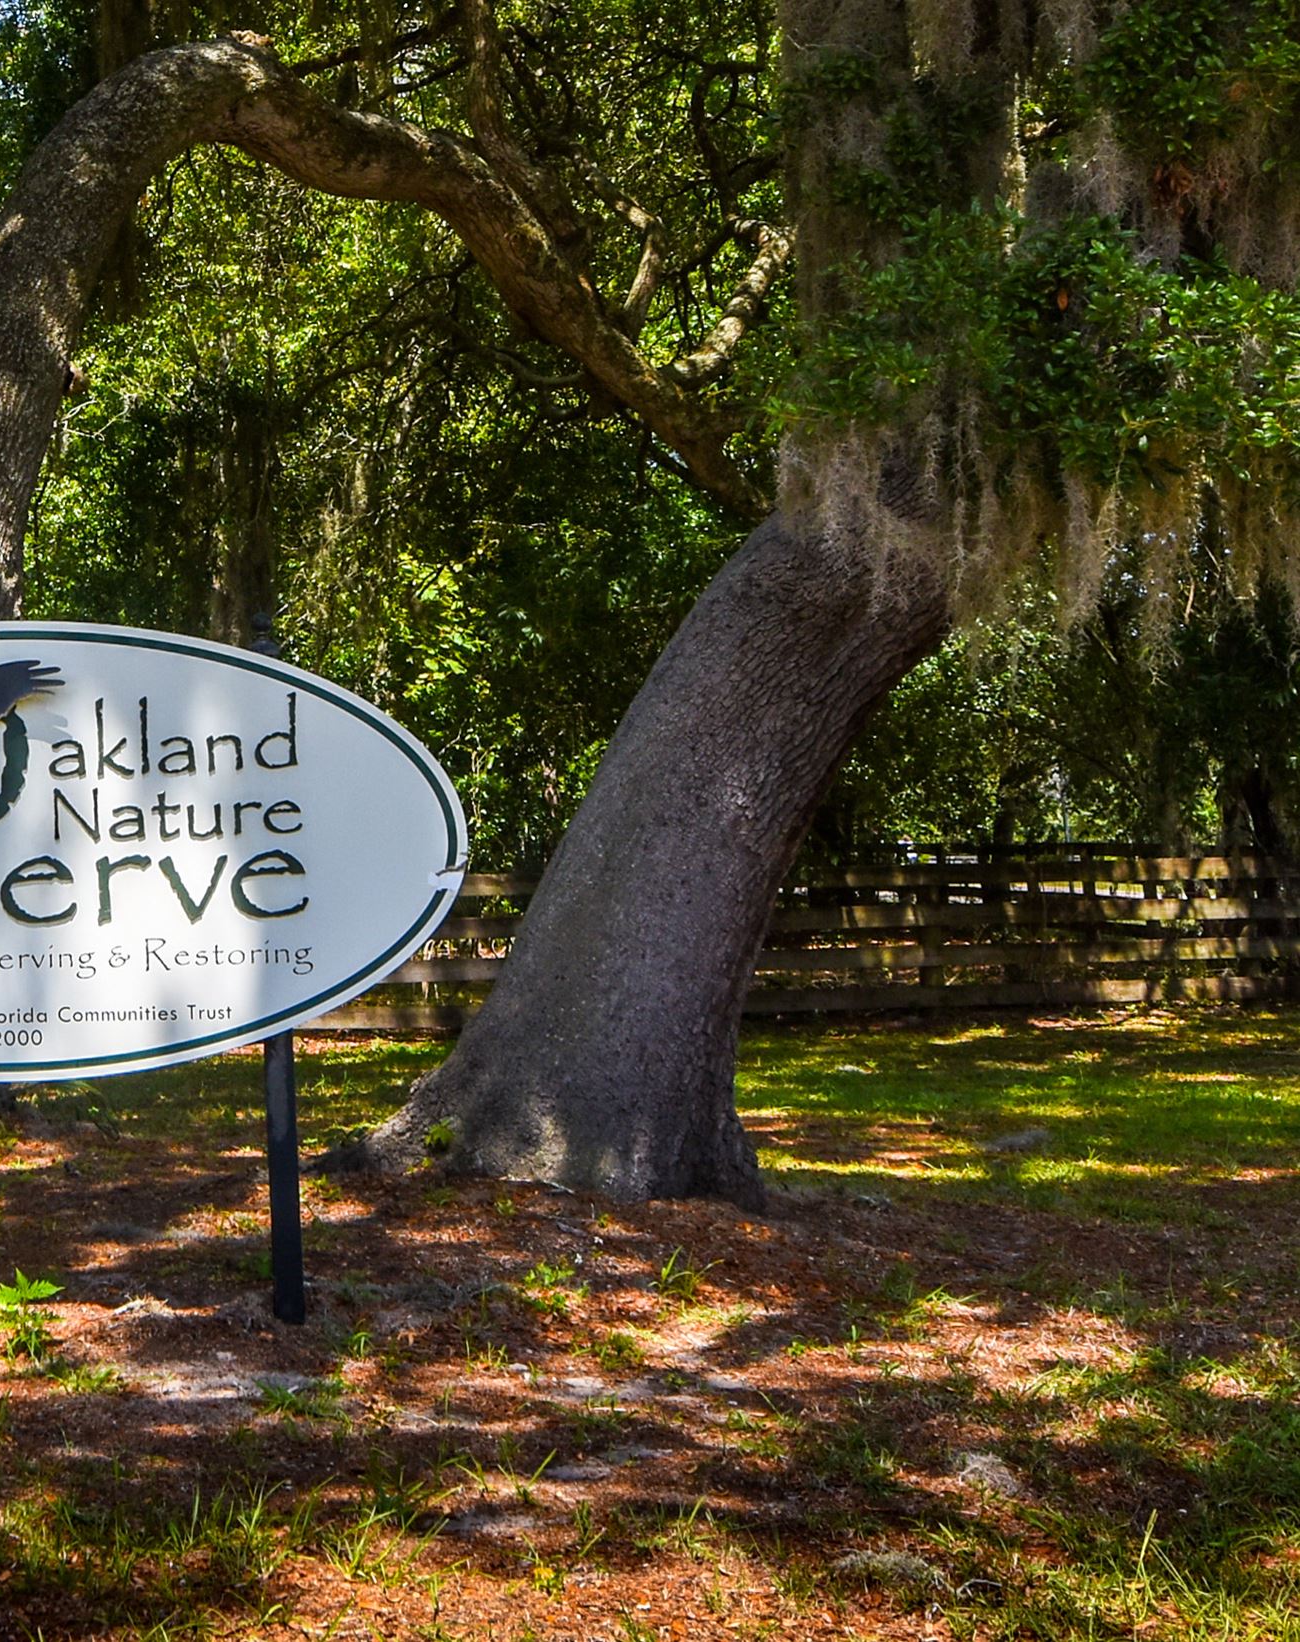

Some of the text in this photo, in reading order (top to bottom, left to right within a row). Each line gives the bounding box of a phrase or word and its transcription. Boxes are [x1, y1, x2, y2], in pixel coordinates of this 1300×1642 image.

[53, 787, 303, 844] Nature
[108, 945, 131, 968] &
[145, 937, 315, 976] Restoring
[57, 1004, 178, 1024] Communities
[187, 1004, 232, 1021] Trust
